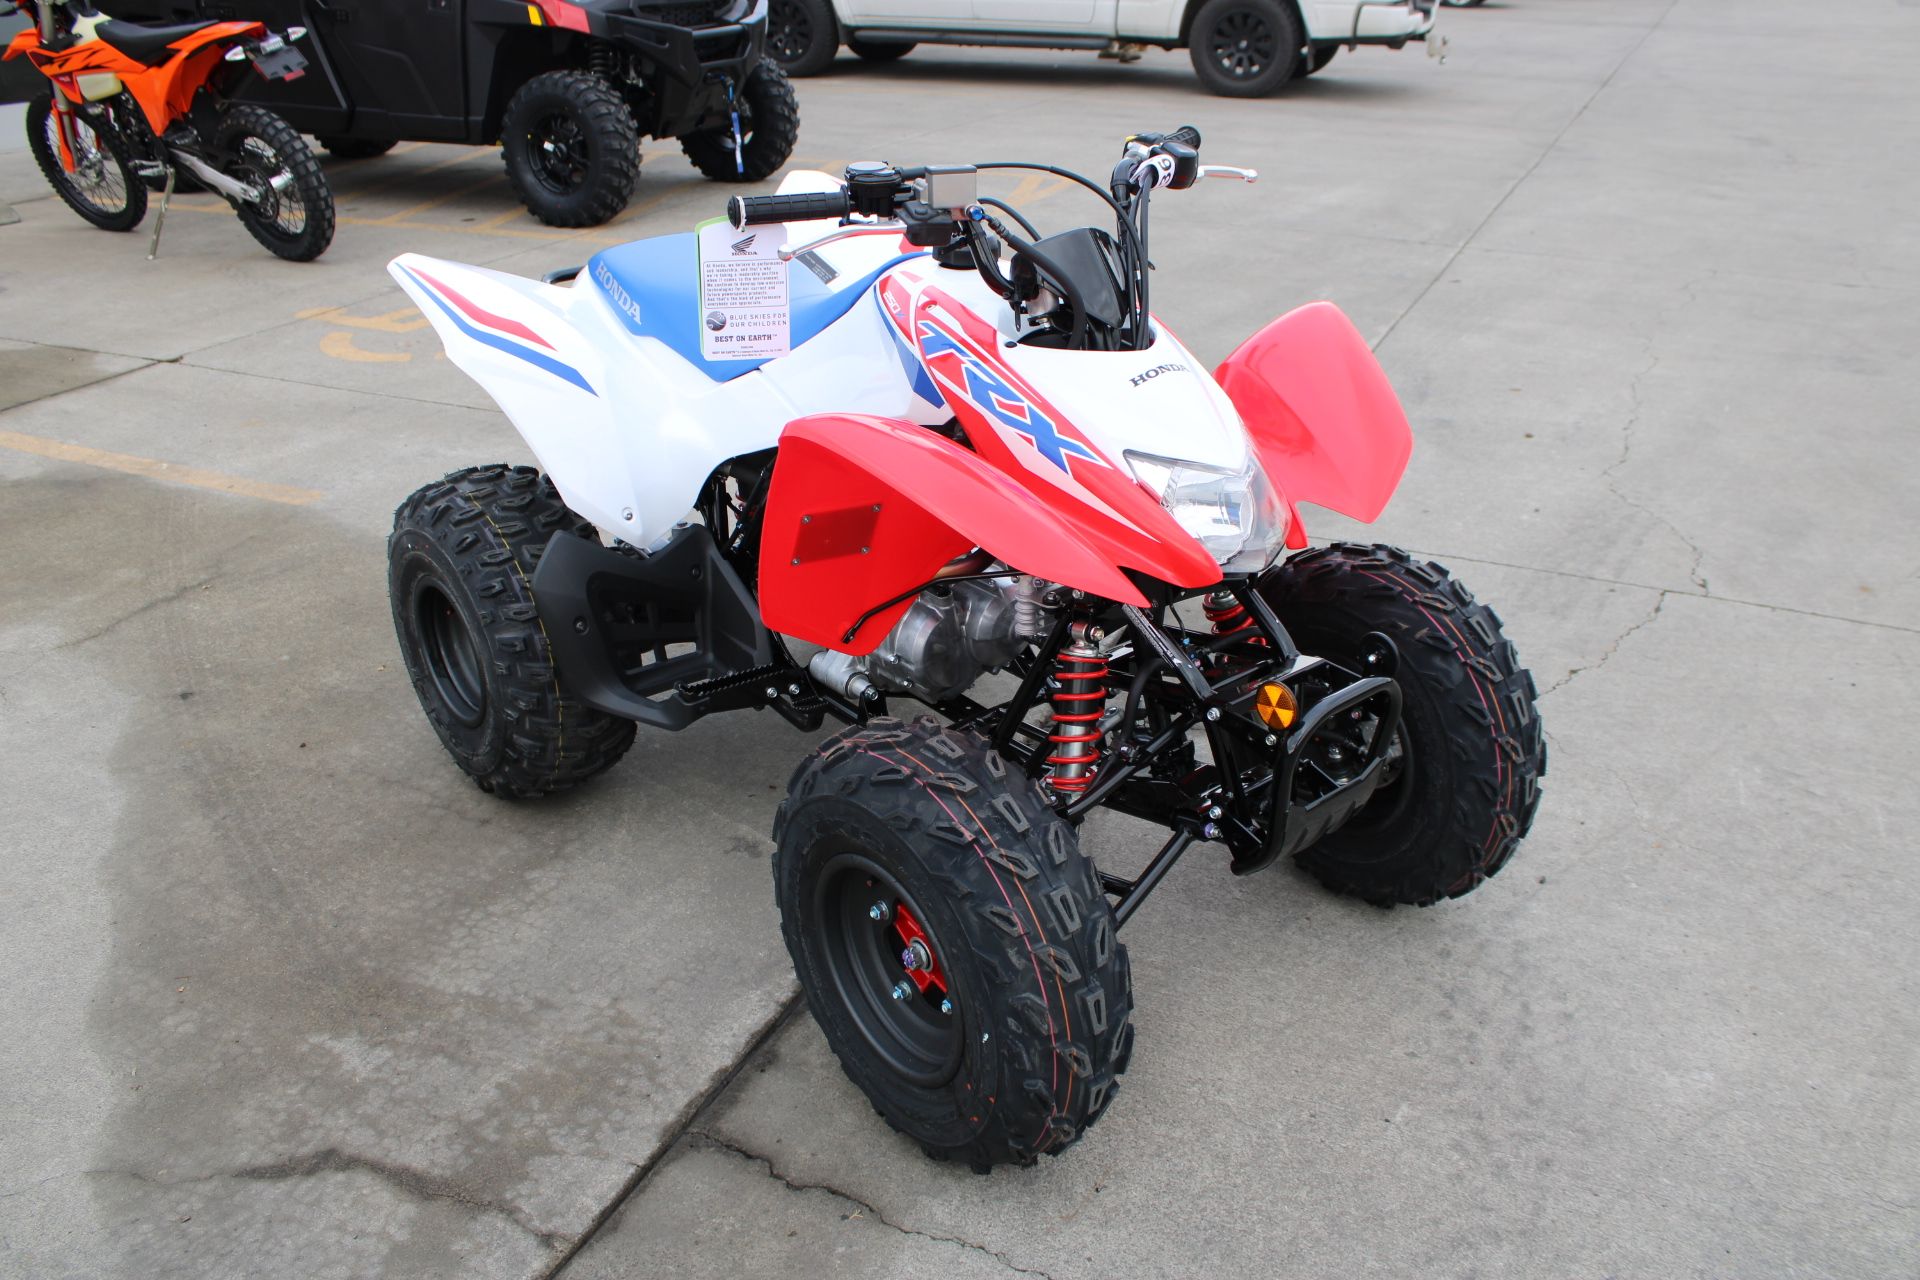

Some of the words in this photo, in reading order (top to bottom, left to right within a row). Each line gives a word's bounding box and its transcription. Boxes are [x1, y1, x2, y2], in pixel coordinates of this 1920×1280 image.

[594, 260, 642, 326] HONDA
[918, 320, 1113, 477] TRX
[1129, 363, 1191, 388] HONDA
